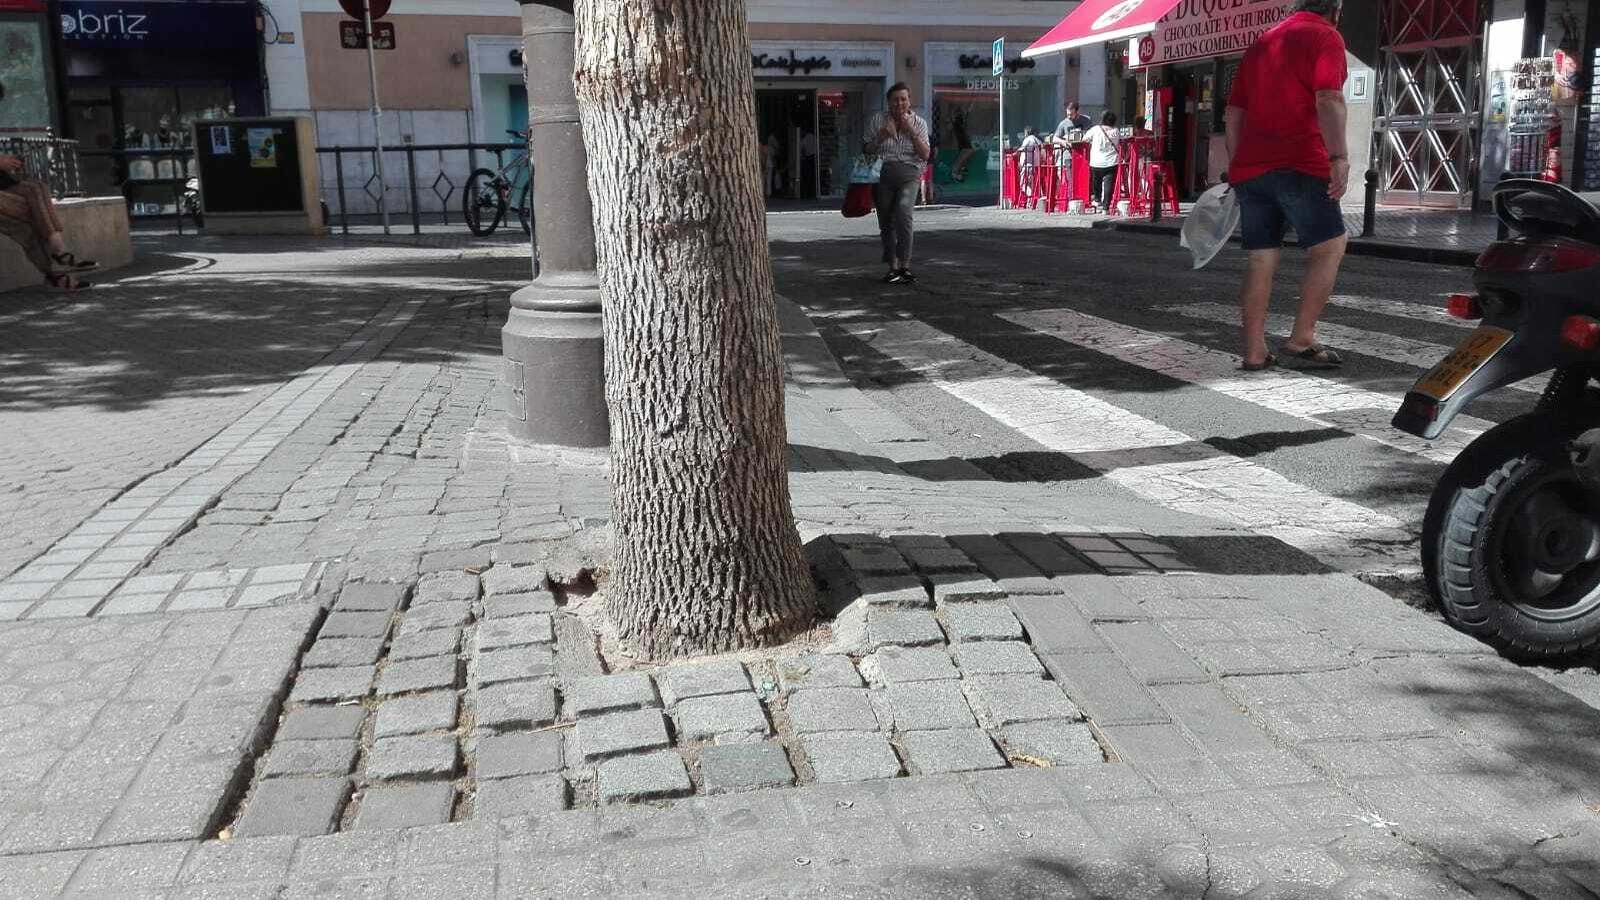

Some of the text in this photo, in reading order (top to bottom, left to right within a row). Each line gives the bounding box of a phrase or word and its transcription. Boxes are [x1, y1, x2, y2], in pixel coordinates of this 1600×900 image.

[1165, 18, 1222, 41] CHOCOLATE
[1224, 17, 1232, 31] Y
[1140, 41, 1154, 58] AB
[1164, 28, 1268, 59] PLATOS COMBINADO
